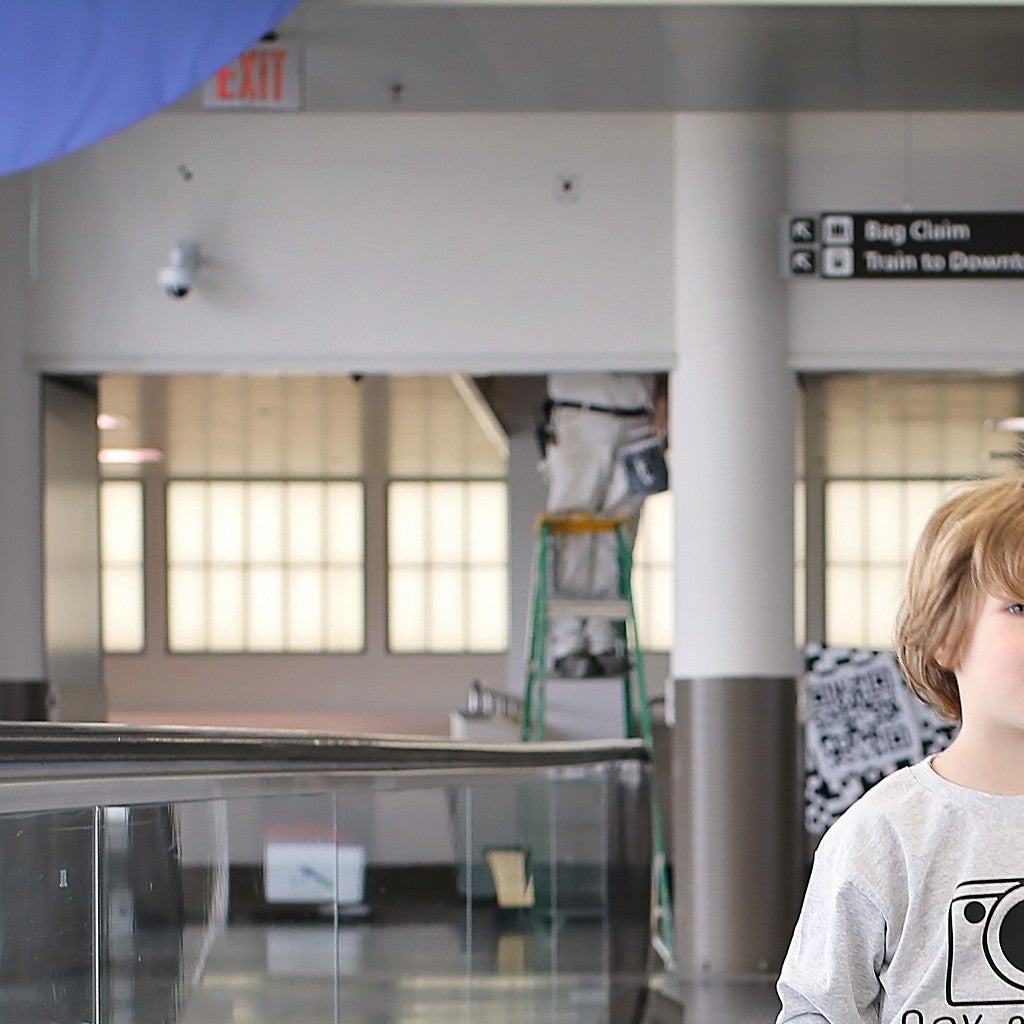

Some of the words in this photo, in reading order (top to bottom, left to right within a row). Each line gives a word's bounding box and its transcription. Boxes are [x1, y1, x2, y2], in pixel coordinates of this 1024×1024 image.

[864, 219, 906, 246] Bag
[909, 219, 970, 242] Claim
[864, 251, 918, 273] Train
[920, 252, 946, 273] to
